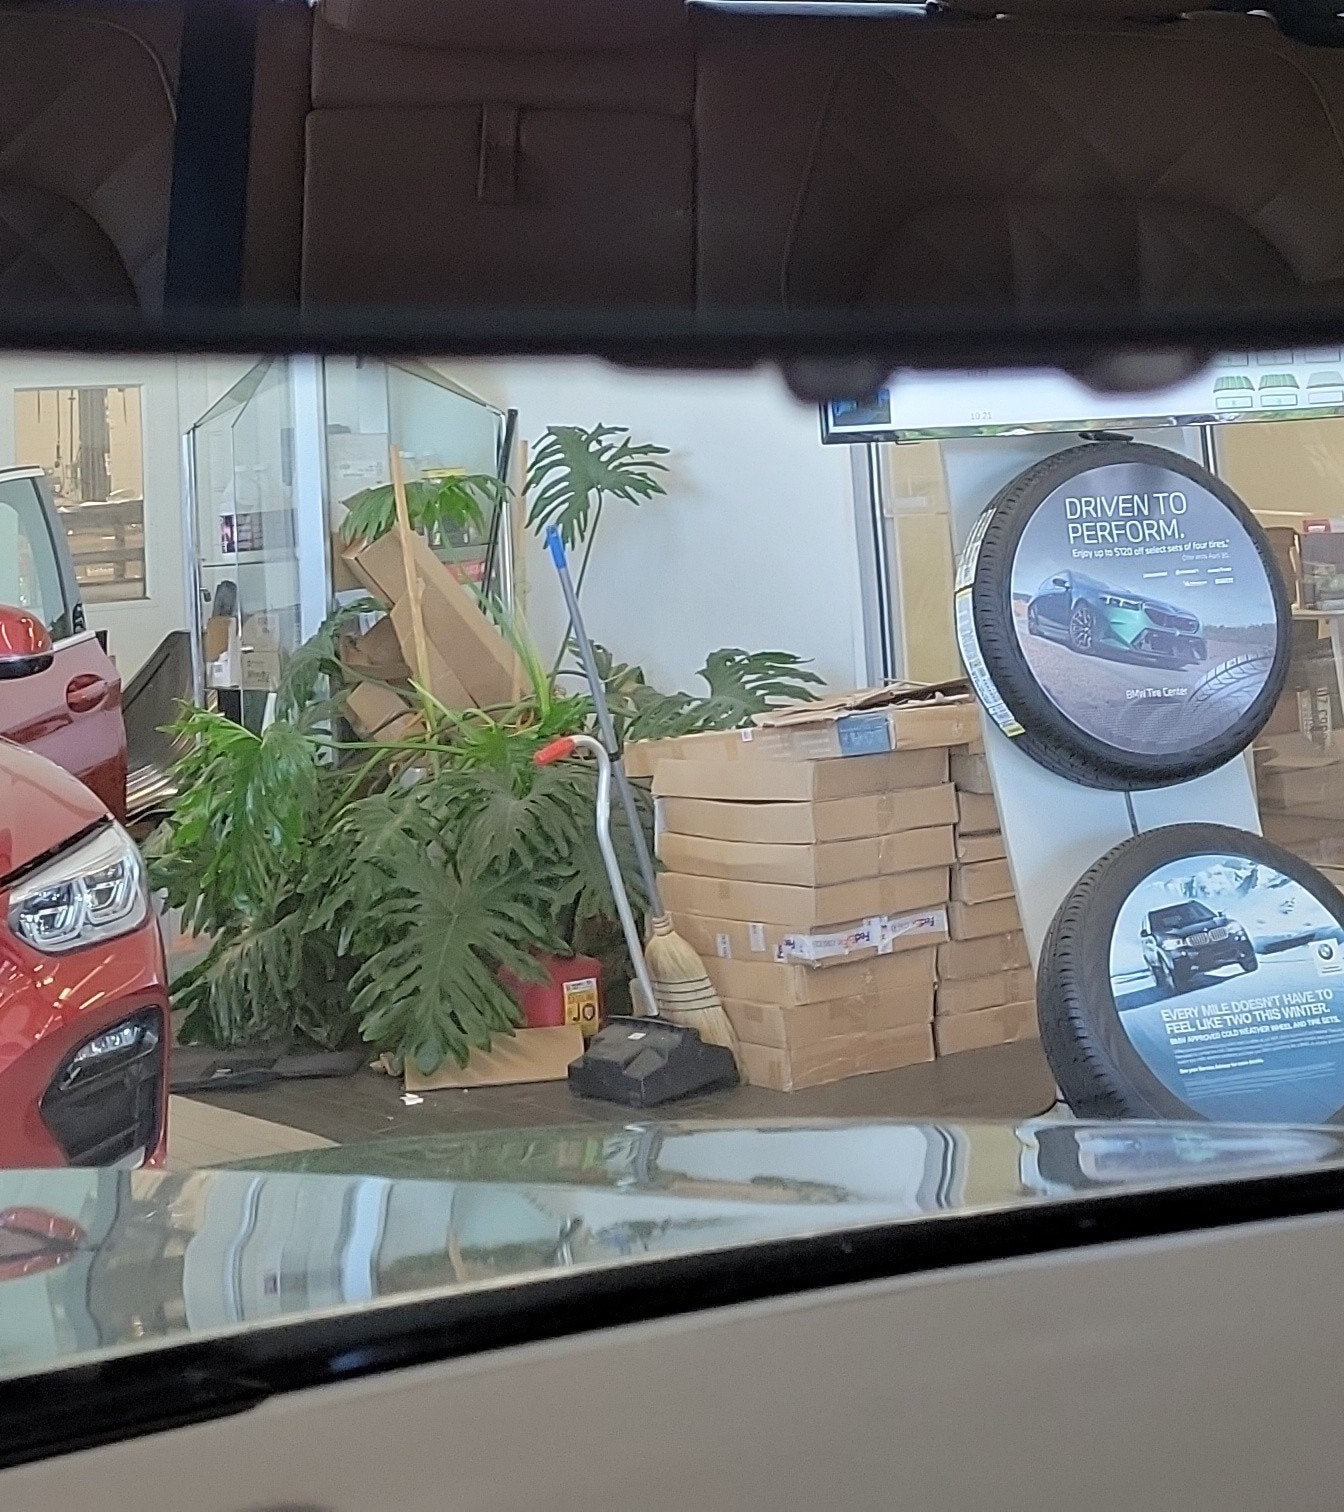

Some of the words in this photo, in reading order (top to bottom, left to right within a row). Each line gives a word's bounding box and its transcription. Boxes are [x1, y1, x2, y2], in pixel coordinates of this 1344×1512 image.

[1065, 493, 1149, 519] DRIVEN
[1153, 492, 1187, 515] TO
[1068, 519, 1185, 544] PERFORM.
[1072, 548, 1093, 559] Enjoy
[1094, 549, 1104, 558] up
[1105, 548, 1113, 557] to
[1134, 546, 1144, 556] off
[1145, 546, 1166, 555] select
[1167, 544, 1183, 553] sets
[1184, 542, 1192, 551] of
[1192, 541, 1207, 550] four
[1126, 689, 1146, 699] BMW
[1146, 688, 1162, 698] Tire
[1162, 687, 1188, 697] Center
[1161, 1006, 1199, 1021] EVERY
[1202, 1002, 1231, 1016] MILE
[1231, 996, 1280, 1012] DOESN'T
[1282, 991, 1316, 1005] HAVE
[1316, 988, 1333, 1000] TO
[1165, 1020, 1196, 1034] FEEL
[1196, 1016, 1224, 1031] LIKE
[1224, 1013, 1252, 1026] TWO
[1252, 1008, 1281, 1022] THIS
[1281, 1002, 1331, 1019] WINTER.
[1169, 1036, 1186, 1045] BMW
[1187, 1032, 1220, 1043] APPROVED
[1221, 1029, 1239, 1038] COLD
[1239, 1025, 1270, 1035] WEATHER
[1271, 1022, 1292, 1031] WHEEL
[1293, 1020, 1306, 1029] AND
[1307, 1017, 1321, 1026] TIRE
